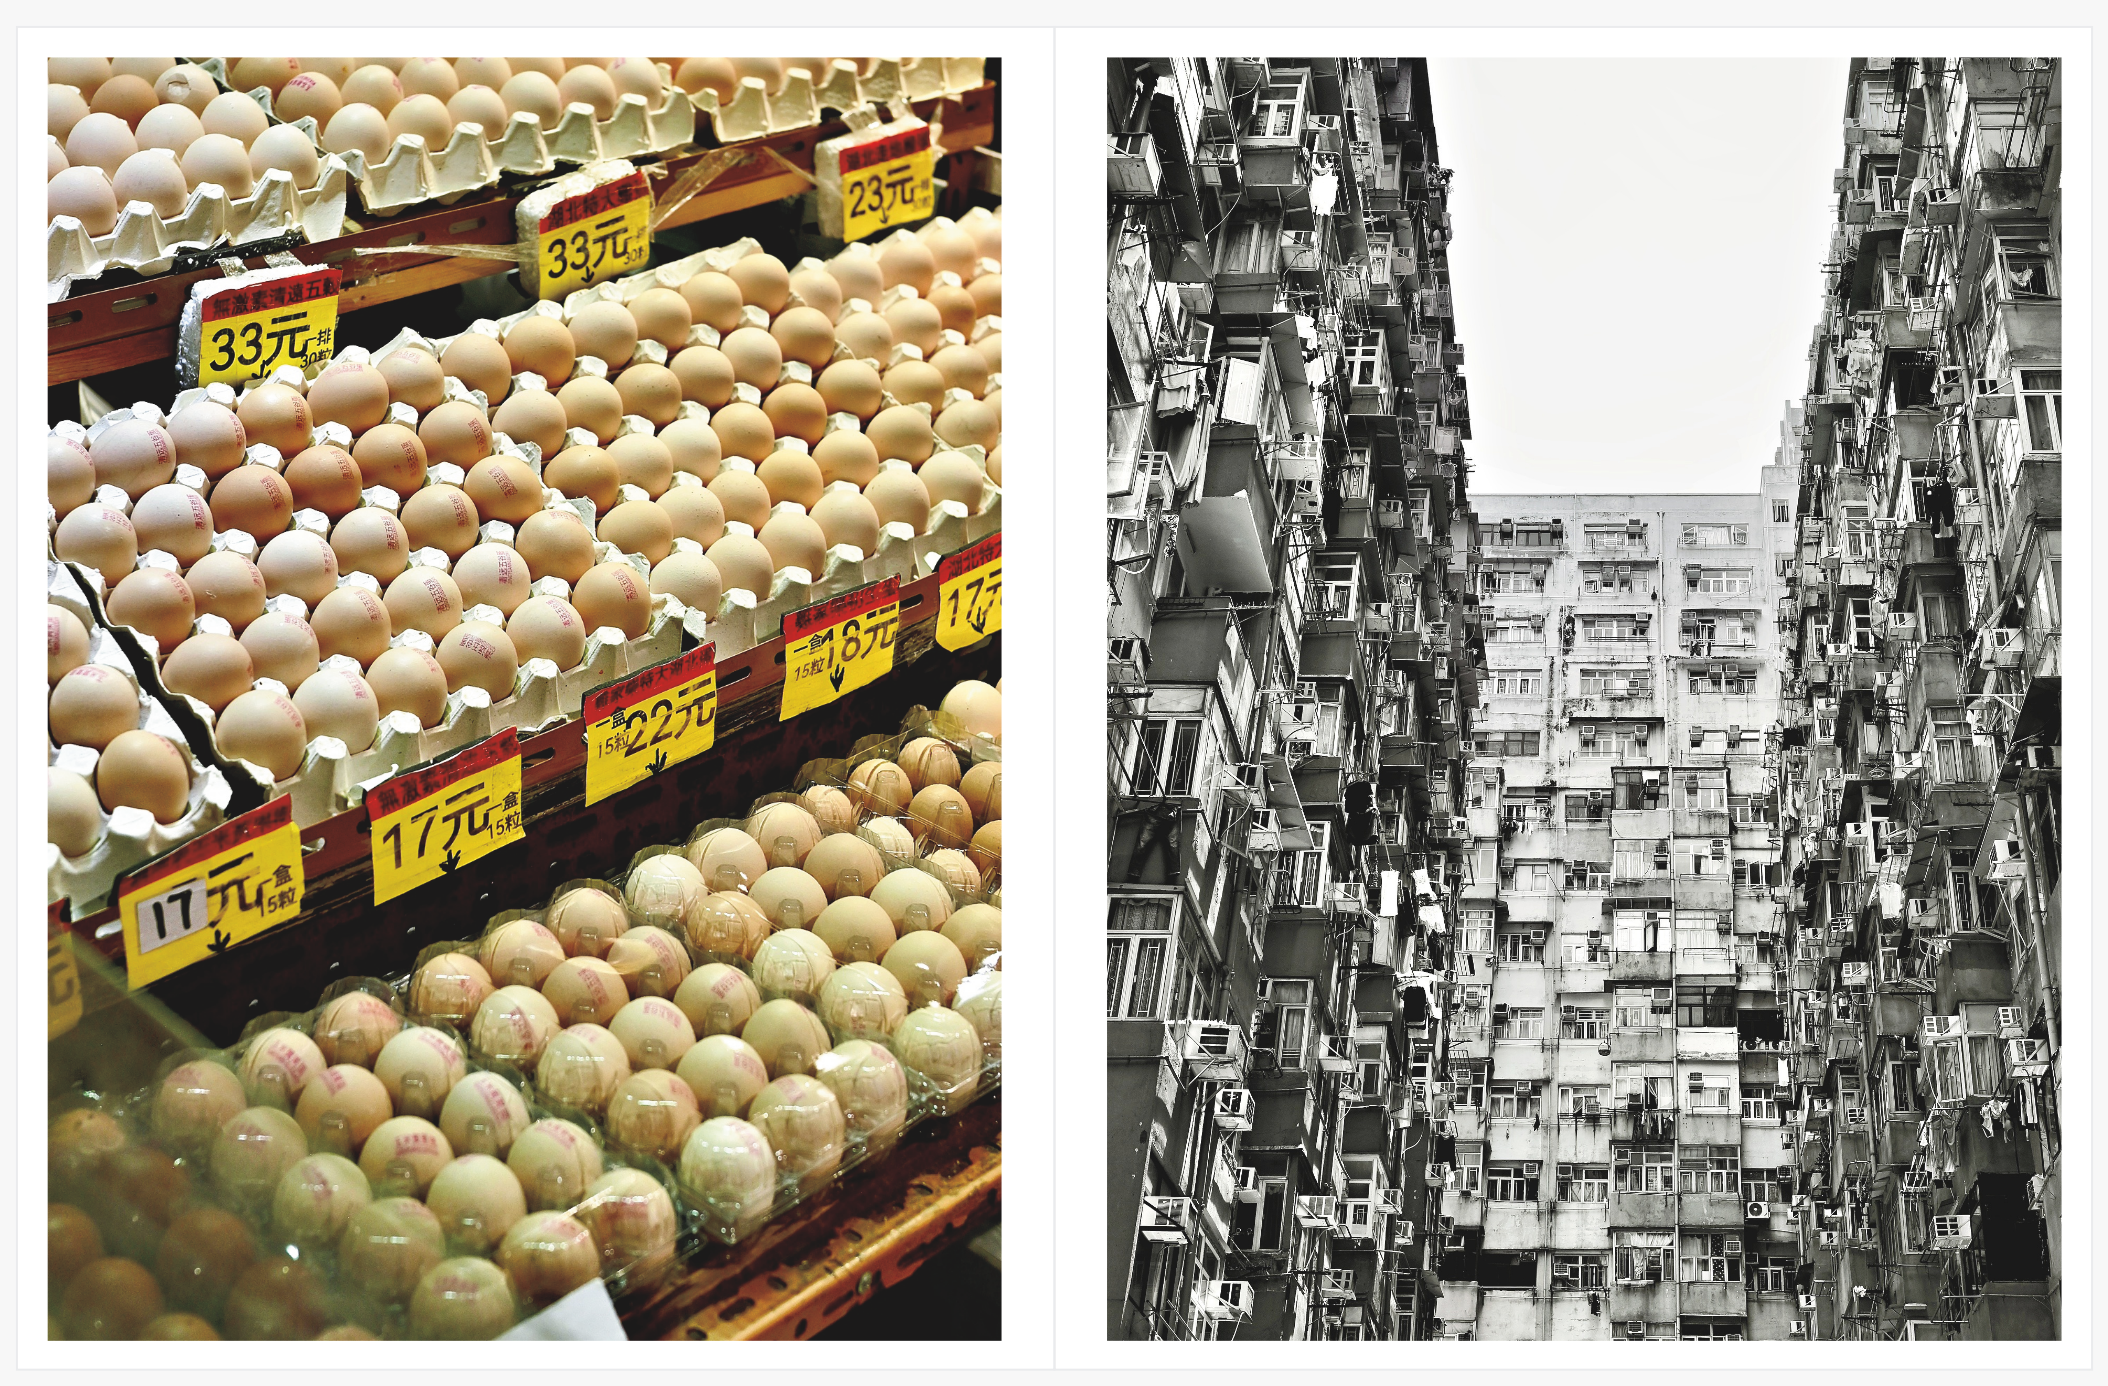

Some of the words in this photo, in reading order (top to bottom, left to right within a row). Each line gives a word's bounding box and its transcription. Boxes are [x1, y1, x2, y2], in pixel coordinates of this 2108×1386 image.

[849, 164, 914, 219] 23元
[547, 215, 628, 279] 33元
[209, 311, 311, 372] 33元
[821, 603, 898, 670] 18元
[624, 677, 716, 759] 22元
[383, 781, 490, 870] 17元
